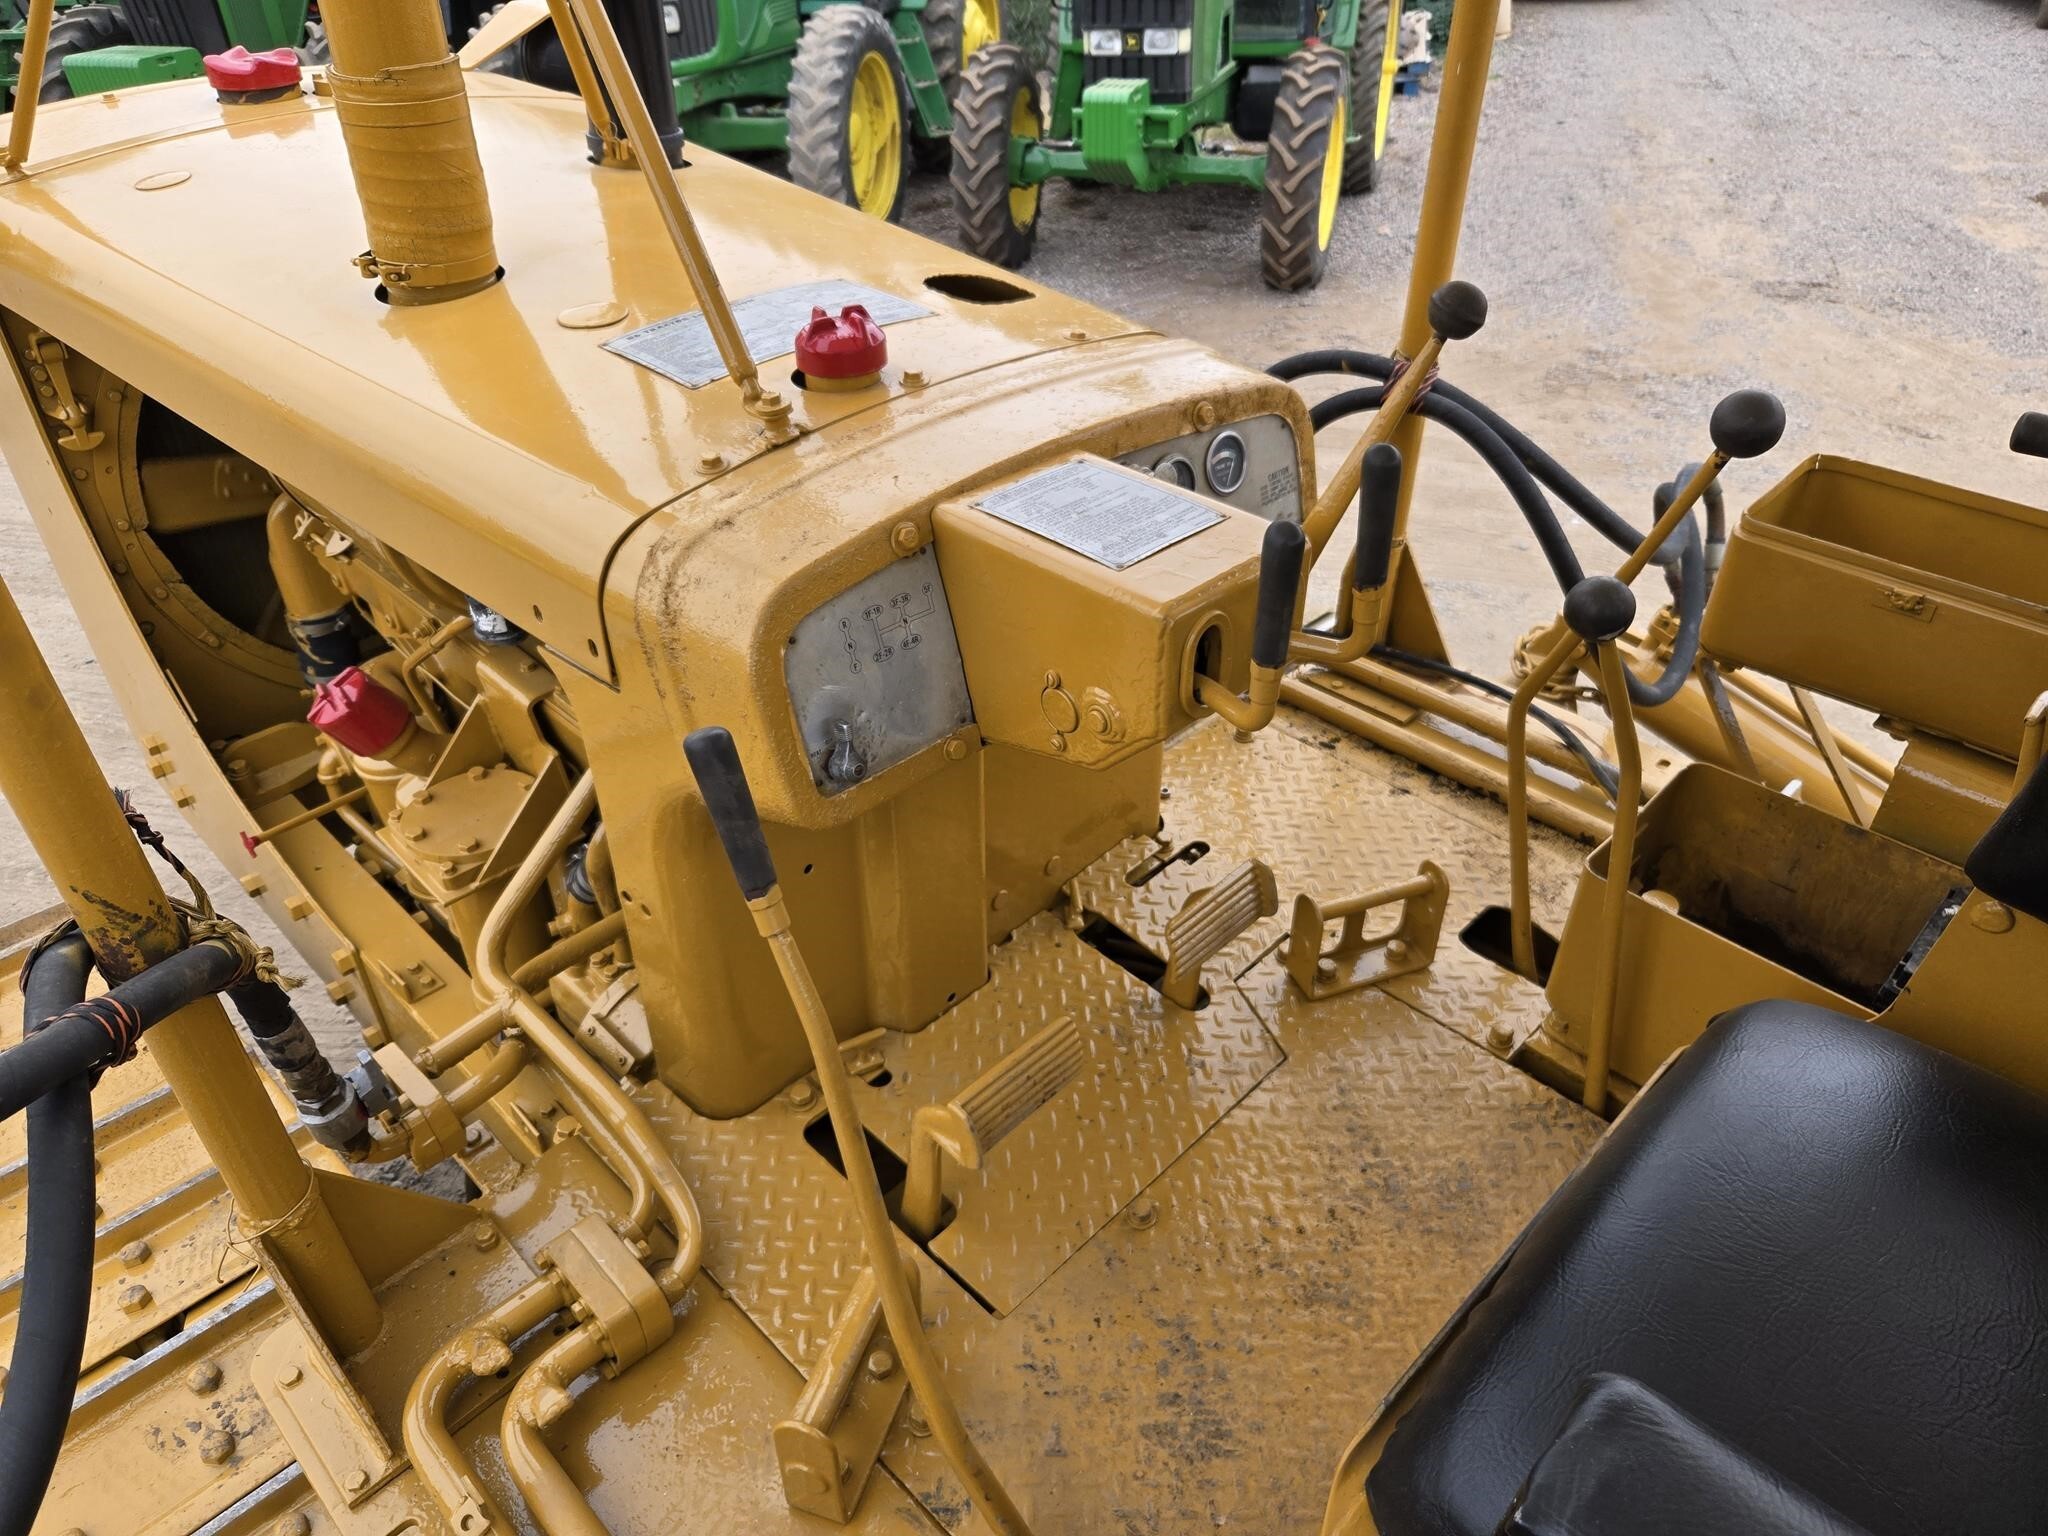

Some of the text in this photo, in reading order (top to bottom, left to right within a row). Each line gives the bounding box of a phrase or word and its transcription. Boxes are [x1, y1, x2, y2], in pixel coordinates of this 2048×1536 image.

[865, 606, 881, 619] 1F-1R
[903, 617, 909, 625] N
[847, 642, 854, 650] N
[874, 647, 892, 661] 2F-2R
